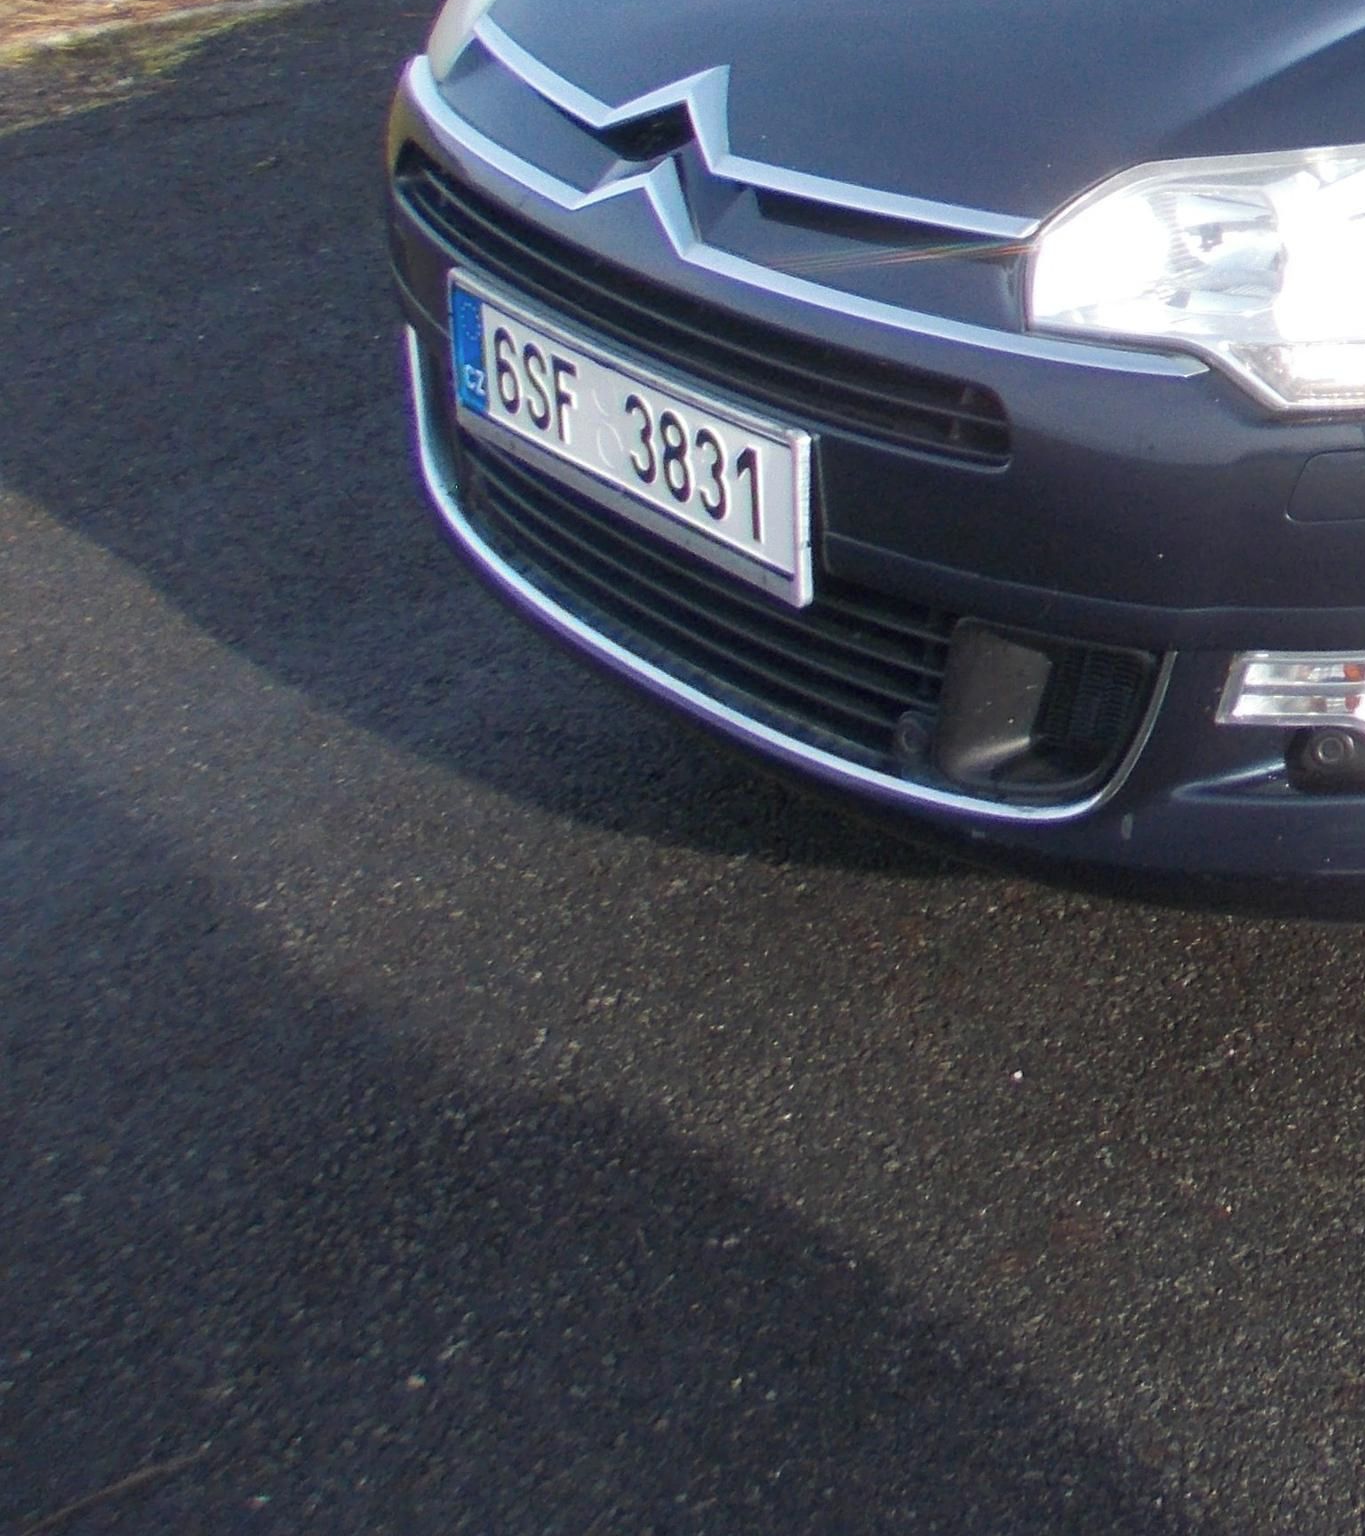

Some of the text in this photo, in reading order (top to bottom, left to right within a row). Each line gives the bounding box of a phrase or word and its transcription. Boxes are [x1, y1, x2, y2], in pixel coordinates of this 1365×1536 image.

[463, 364, 486, 395] CZ
[494, 326, 762, 543] 6SF 3831
